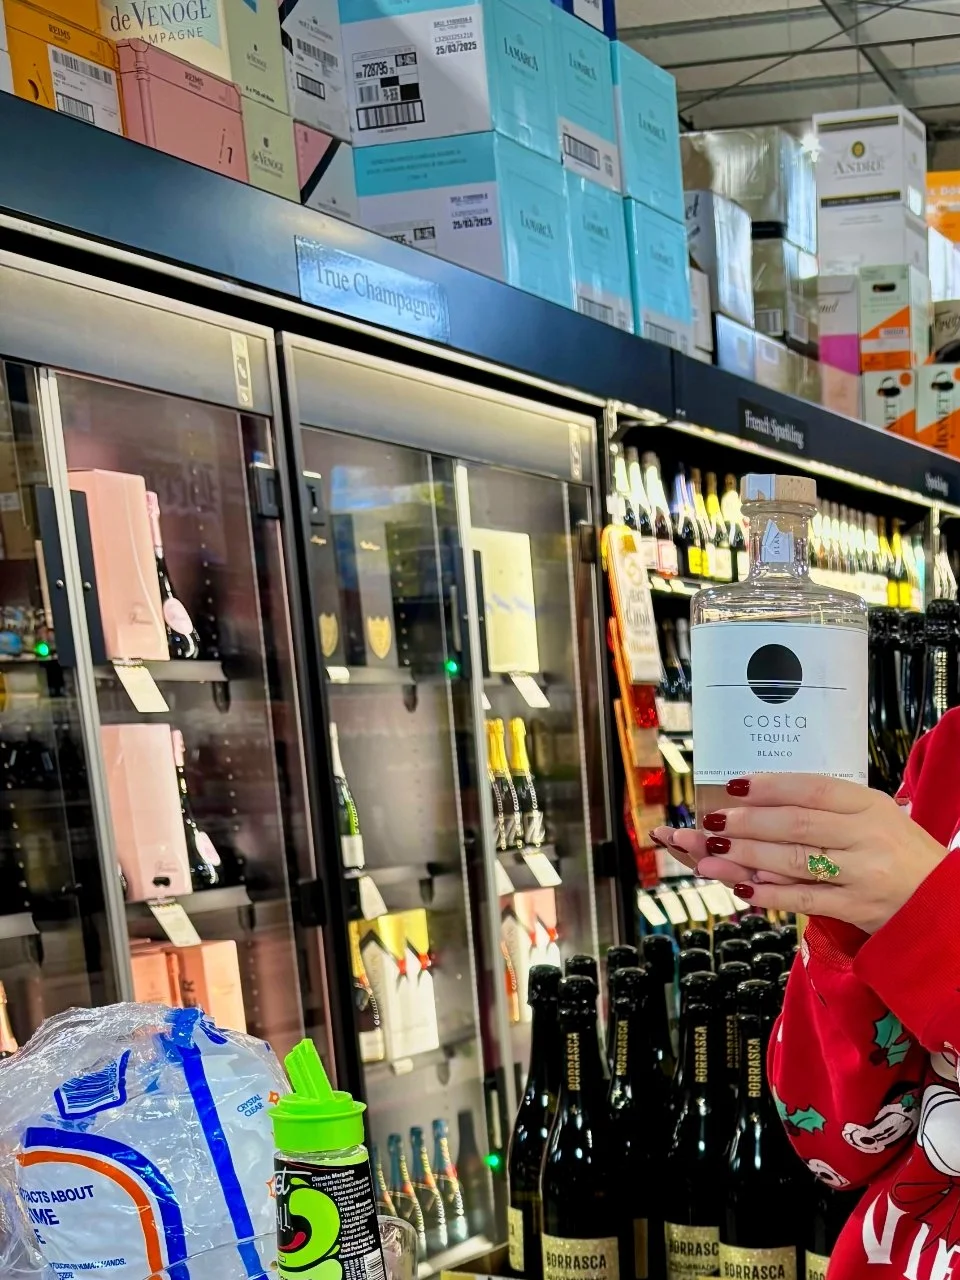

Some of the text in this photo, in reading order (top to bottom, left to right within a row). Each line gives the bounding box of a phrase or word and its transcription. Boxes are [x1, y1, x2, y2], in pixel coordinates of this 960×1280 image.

[111, 0, 212, 31] de VENOGE
[49, 24, 71, 40] REIMS
[184, 71, 204, 87] REIMS
[314, 259, 437, 322] True Champagne
[745, 408, 804, 449] French Sparkling
[743, 713, 808, 729] costa
[750, 733, 801, 744] TEQUILA
[616, 1019, 629, 1076] BORRASCA
[695, 1026, 708, 1083] BORRASCA
[568, 1032, 580, 1091] BORRASCA
[749, 1037, 761, 1098] BORRASCA
[236, 1094, 262, 1113] CRYSTAL
[244, 1103, 264, 1117] CLEAR
[51, 1185, 94, 1203] ABOUT
[669, 1239, 720, 1258] BORRASC
[546, 1252, 608, 1270] BORRASCA
[724, 1261, 786, 1280] BORRASCA
